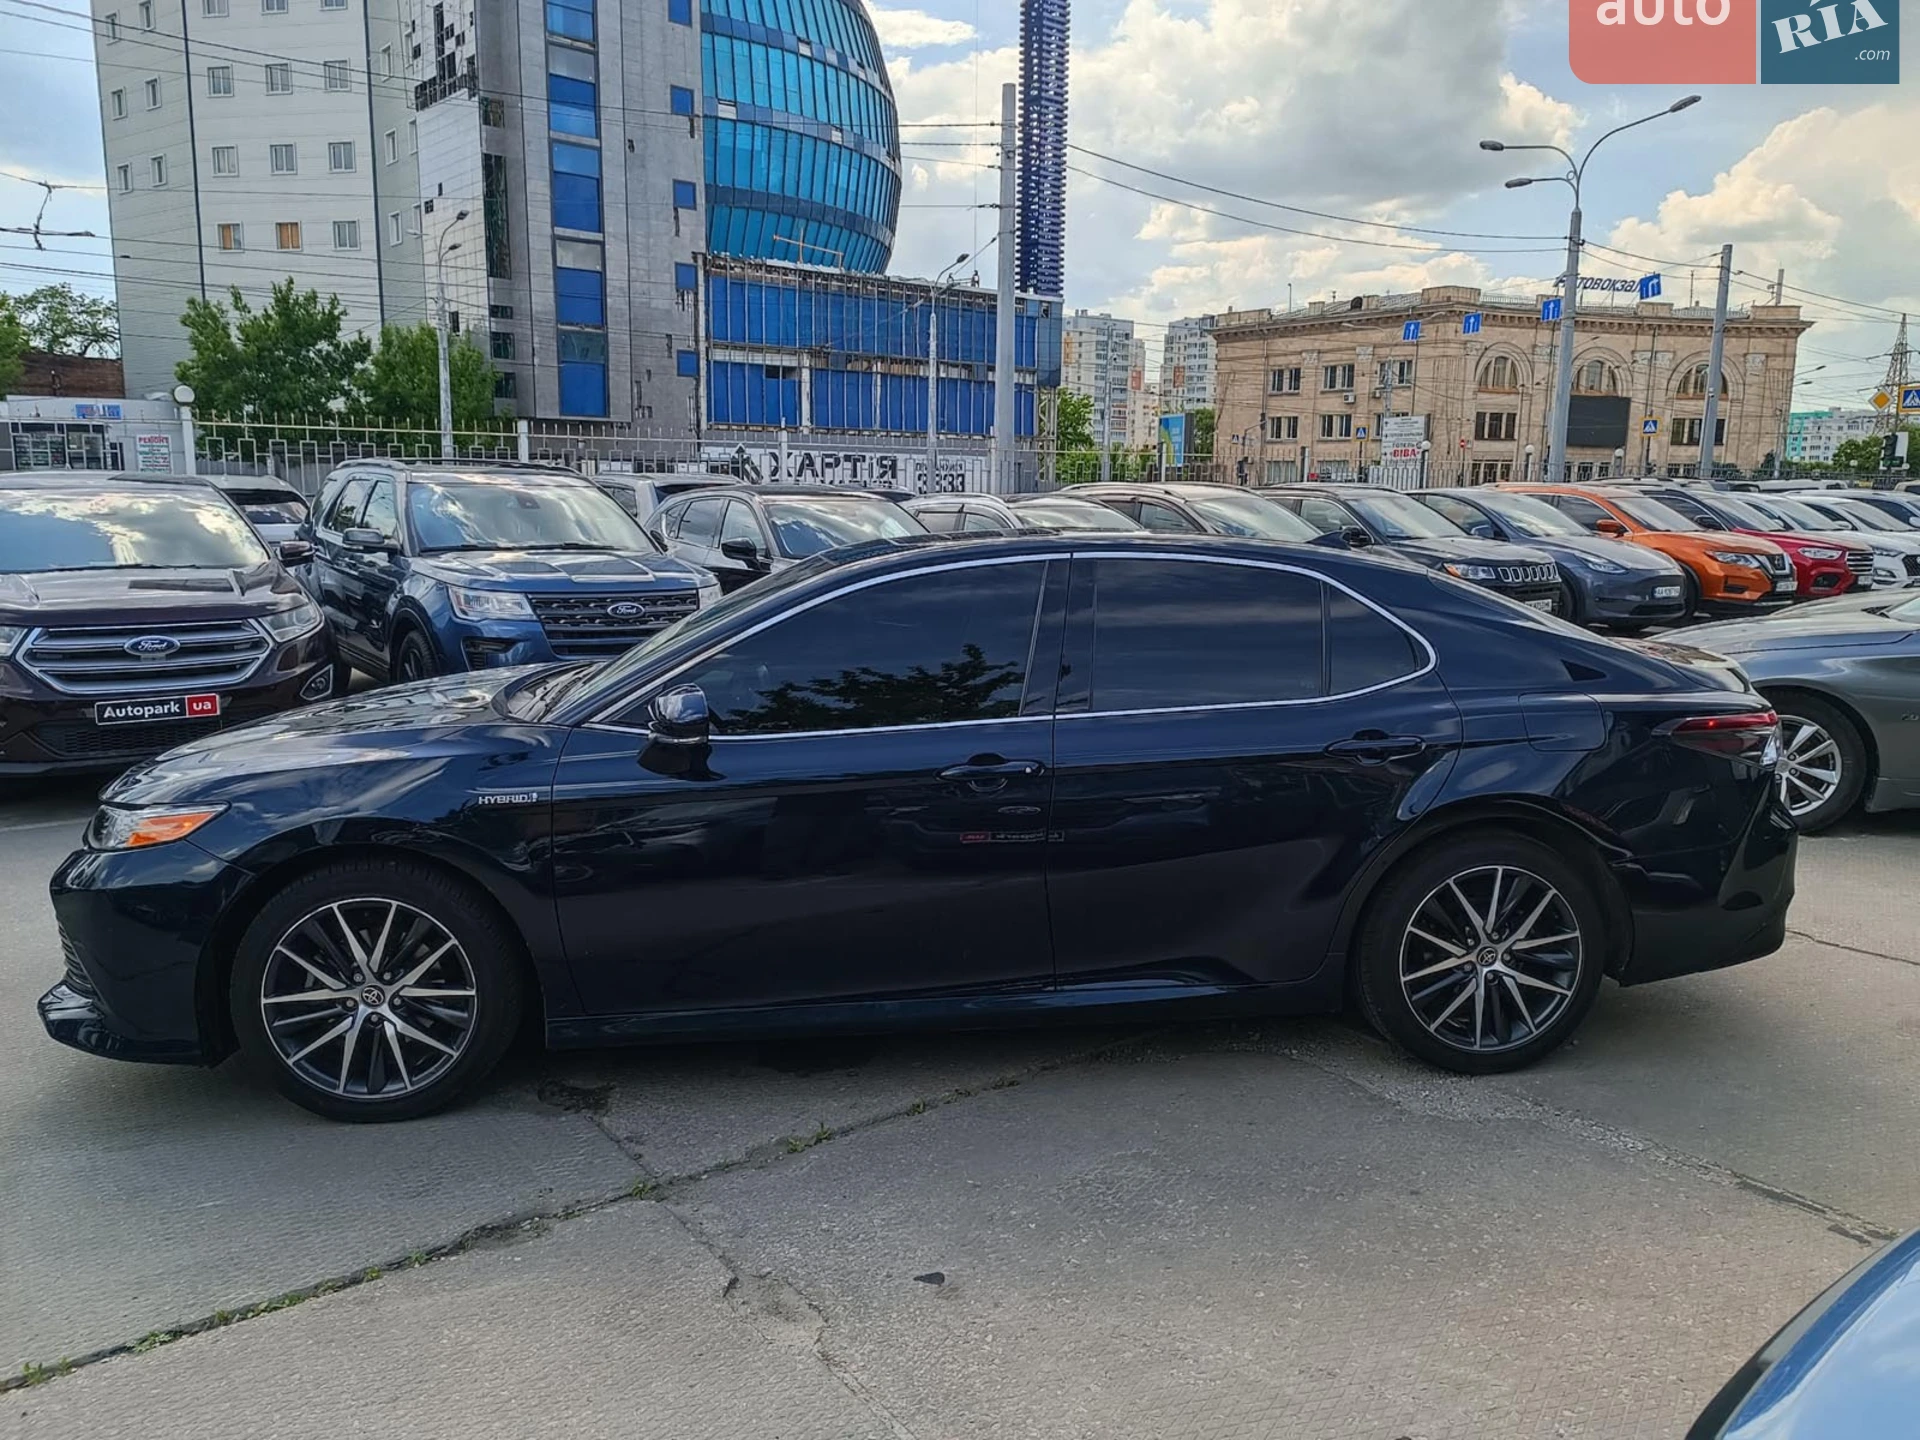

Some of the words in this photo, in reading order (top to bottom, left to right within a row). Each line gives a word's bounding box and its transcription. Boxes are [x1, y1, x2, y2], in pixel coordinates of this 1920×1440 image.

[103, 701, 181, 718] Autopark
[192, 701, 212, 711] ua
[478, 794, 529, 805] HYBRID
